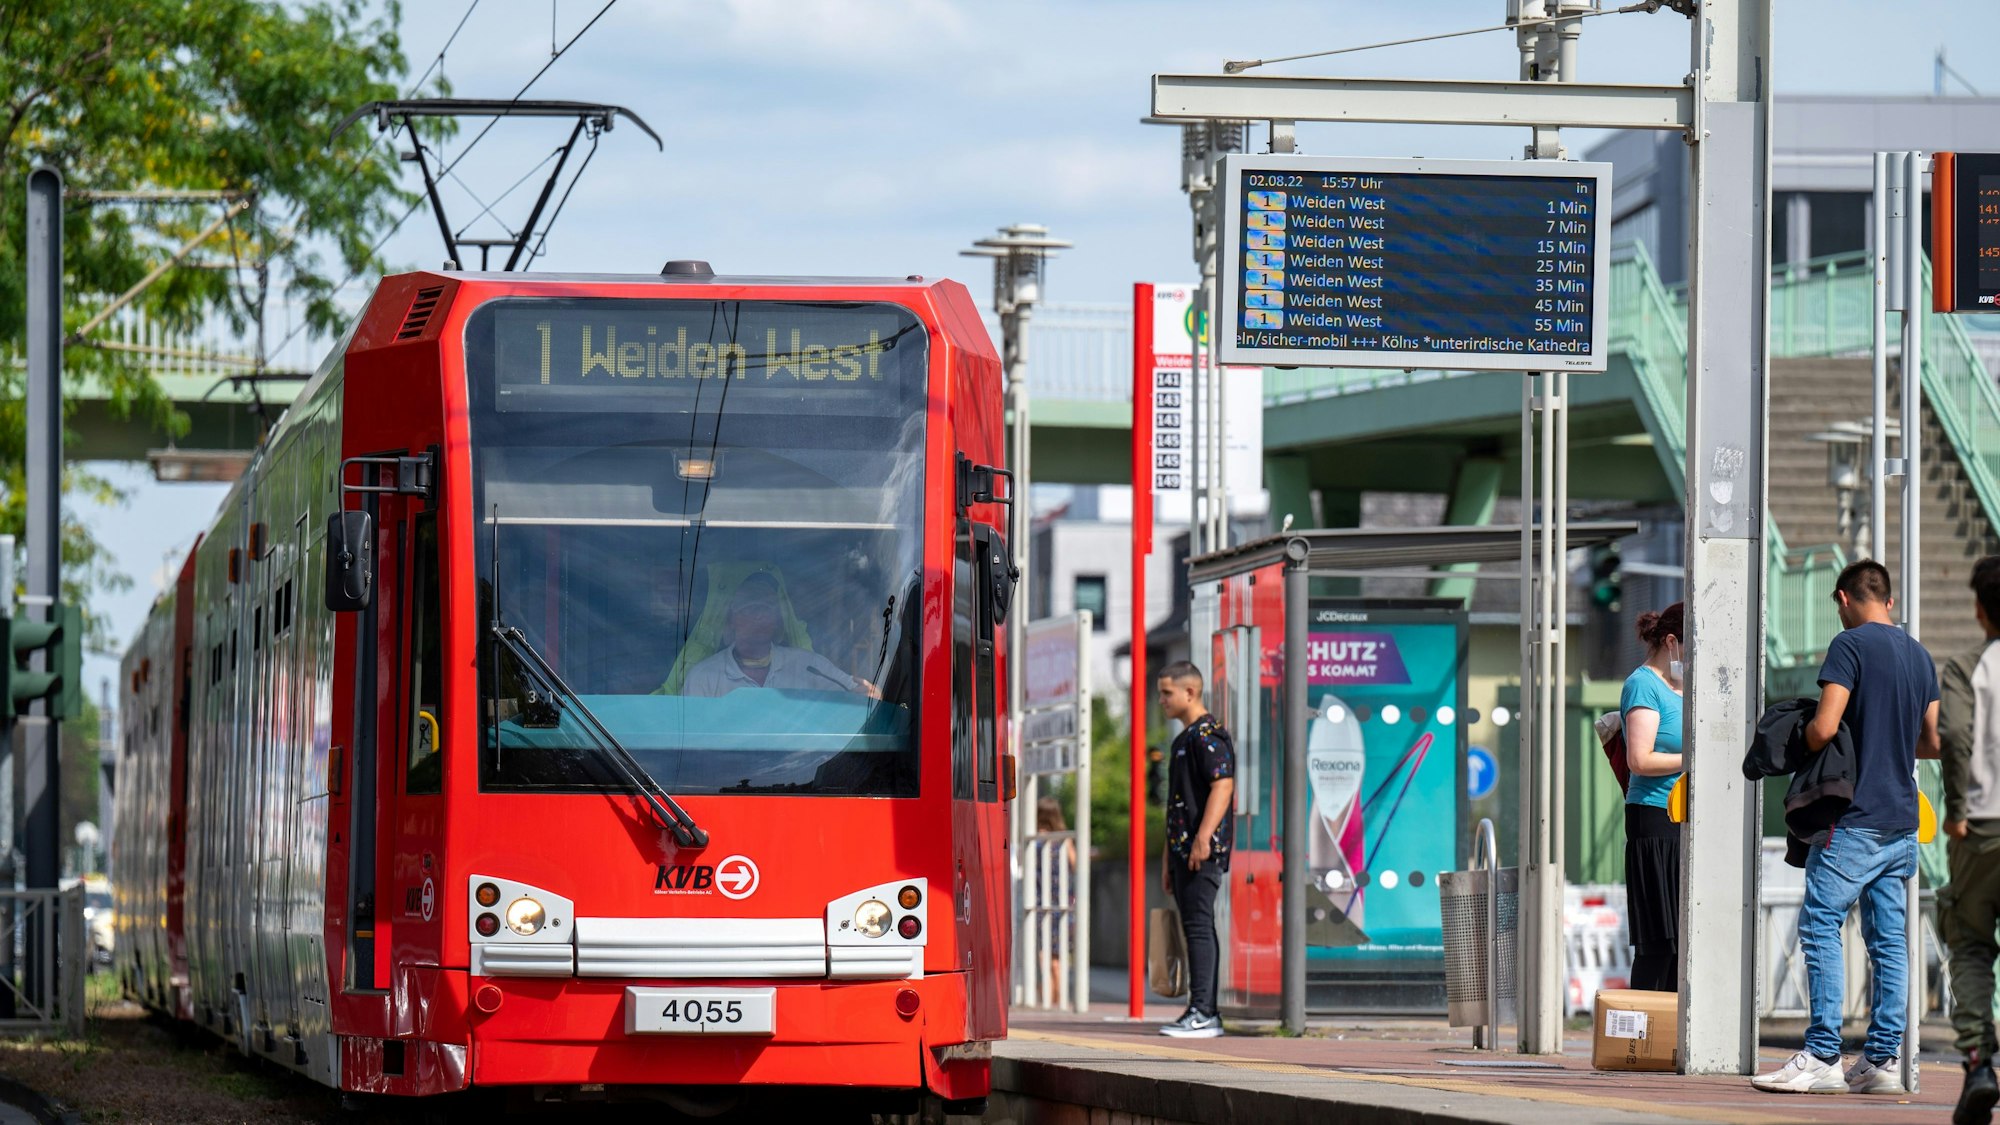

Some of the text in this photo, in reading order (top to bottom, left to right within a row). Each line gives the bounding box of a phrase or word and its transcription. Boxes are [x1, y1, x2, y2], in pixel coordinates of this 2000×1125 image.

[1249, 174, 1588, 193] 02.08.22 15:57 Uhr in
[1263, 194, 1587, 214] 1 Weiden West 1 Min
[1979, 204, 1999, 215] 141
[1263, 214, 1586, 234] 1 Weiden West 7 Min
[1262, 234, 1586, 254] 1 Weiden West 15 Min
[1979, 247, 2000, 257] 145
[1262, 254, 1585, 273] 1 Weiden West 25 Min
[1261, 273, 1585, 293] 1 Weiden West 35 Min
[1260, 293, 1584, 313] 1 Weiden West 45 Min
[1978, 295, 1995, 304] KVB
[1260, 313, 1584, 332] 1 Weiden West 55 Min
[1237, 331, 1348, 348] eln/sicher-mobil
[1381, 335, 1419, 349] Kölns
[1527, 338, 1590, 353] Kathedra
[536, 320, 884, 385] 1 Weiden West
[1157, 374, 1180, 387] 141
[1316, 611, 1368, 622] JCDecaux
[1320, 664, 1378, 677] KOMMT
[528, 690, 536, 704] 3
[1311, 758, 1361, 772] Rexona
[655, 865, 714, 889] KVB
[662, 999, 743, 1023] 4055
